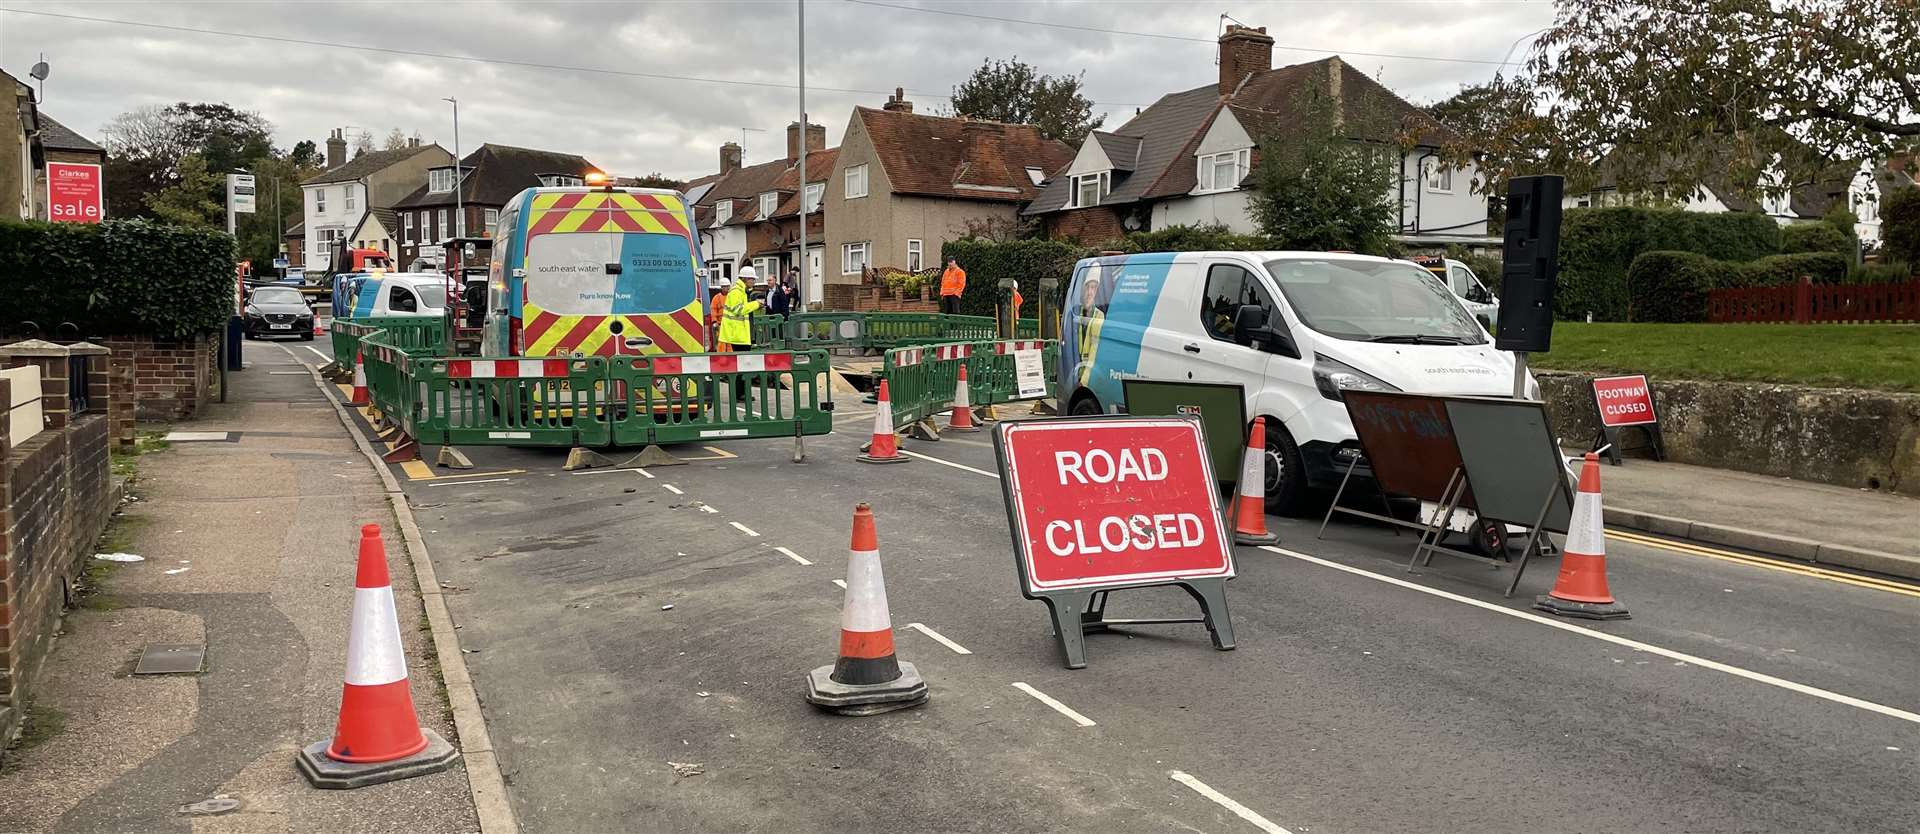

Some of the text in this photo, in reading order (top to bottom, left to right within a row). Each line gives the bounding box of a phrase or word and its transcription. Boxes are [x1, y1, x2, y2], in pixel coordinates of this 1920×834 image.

[59, 170, 89, 178] Clarkes
[53, 200, 97, 217] sale
[1598, 386, 1645, 399] FOOTWAY
[1177, 405, 1200, 413] CTM
[1606, 402, 1647, 415] CLOSED
[1055, 447, 1169, 486] ROAD
[1045, 512, 1205, 556] CLOSED
